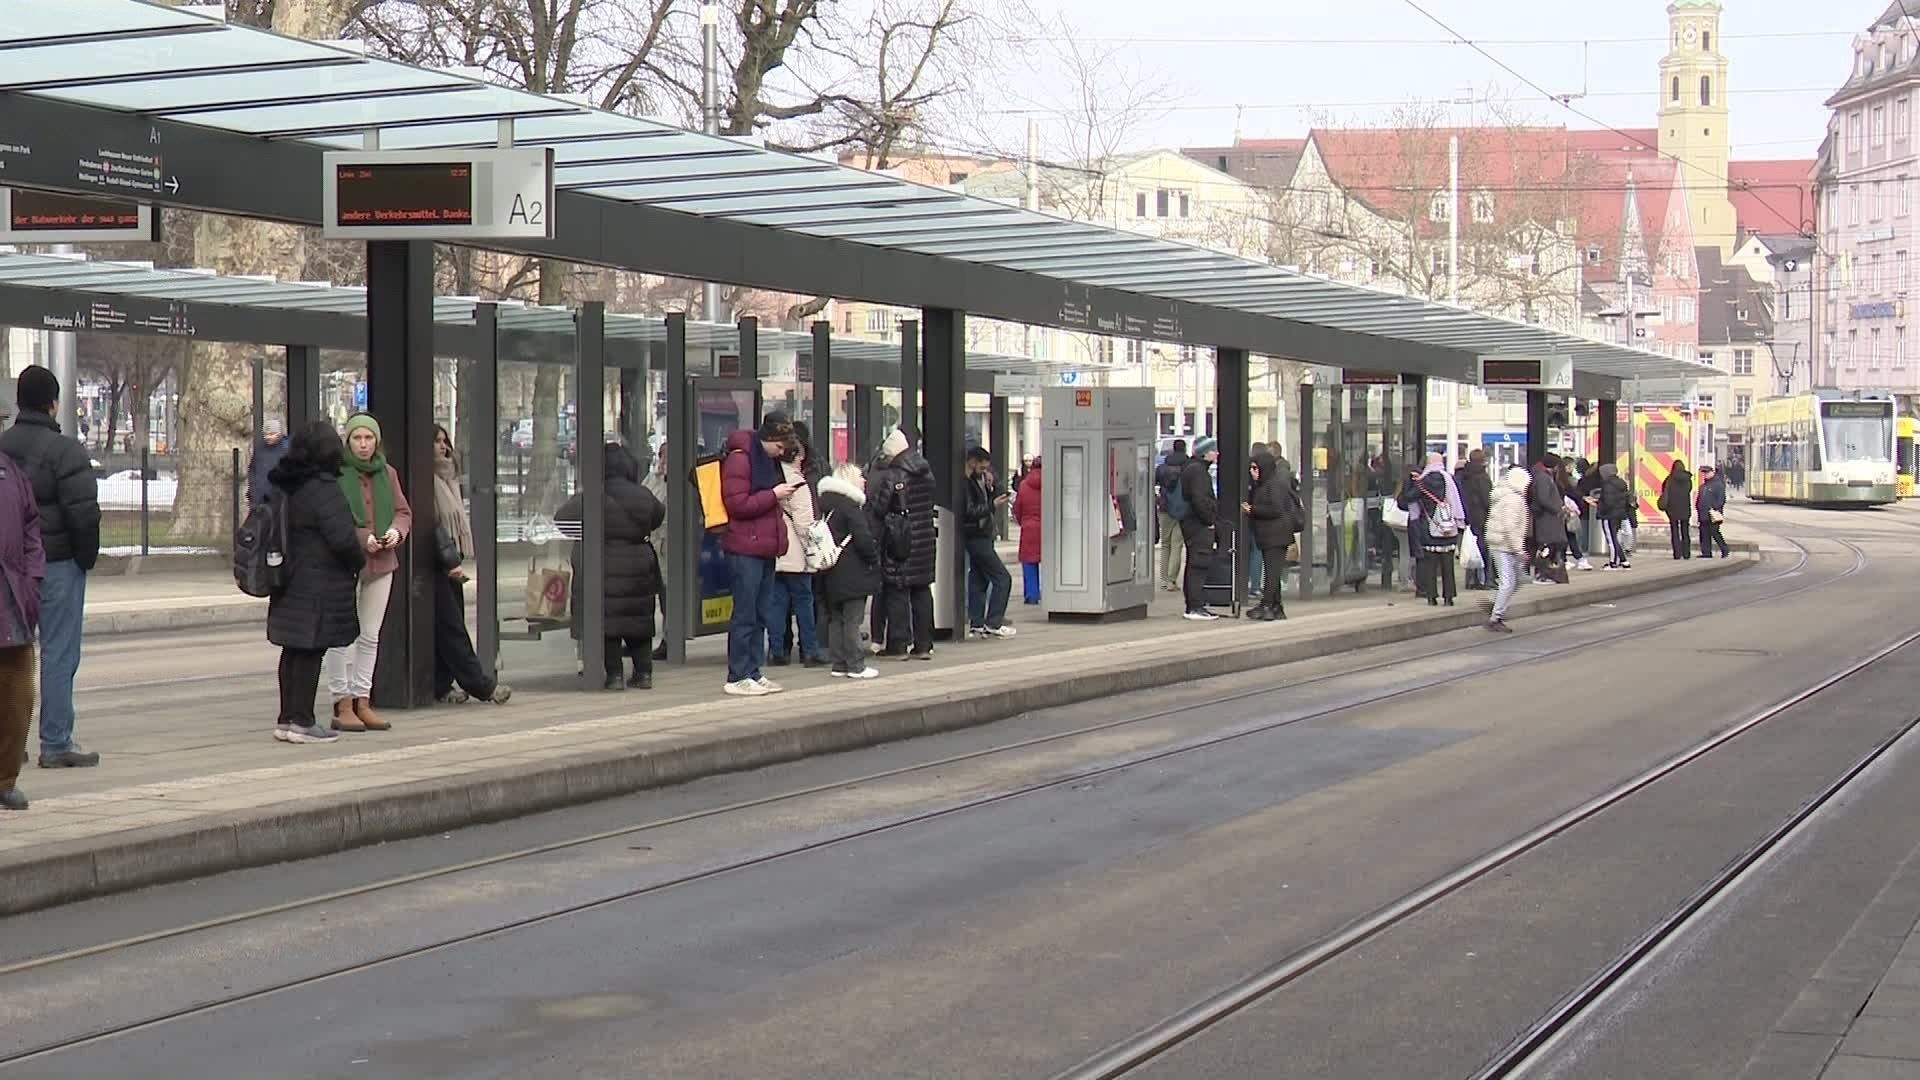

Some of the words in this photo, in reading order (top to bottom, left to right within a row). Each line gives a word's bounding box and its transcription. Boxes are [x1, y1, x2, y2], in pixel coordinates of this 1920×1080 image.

[150, 126, 161, 144] A1
[508, 193, 543, 225] A2
[74, 311, 86, 328] A4
